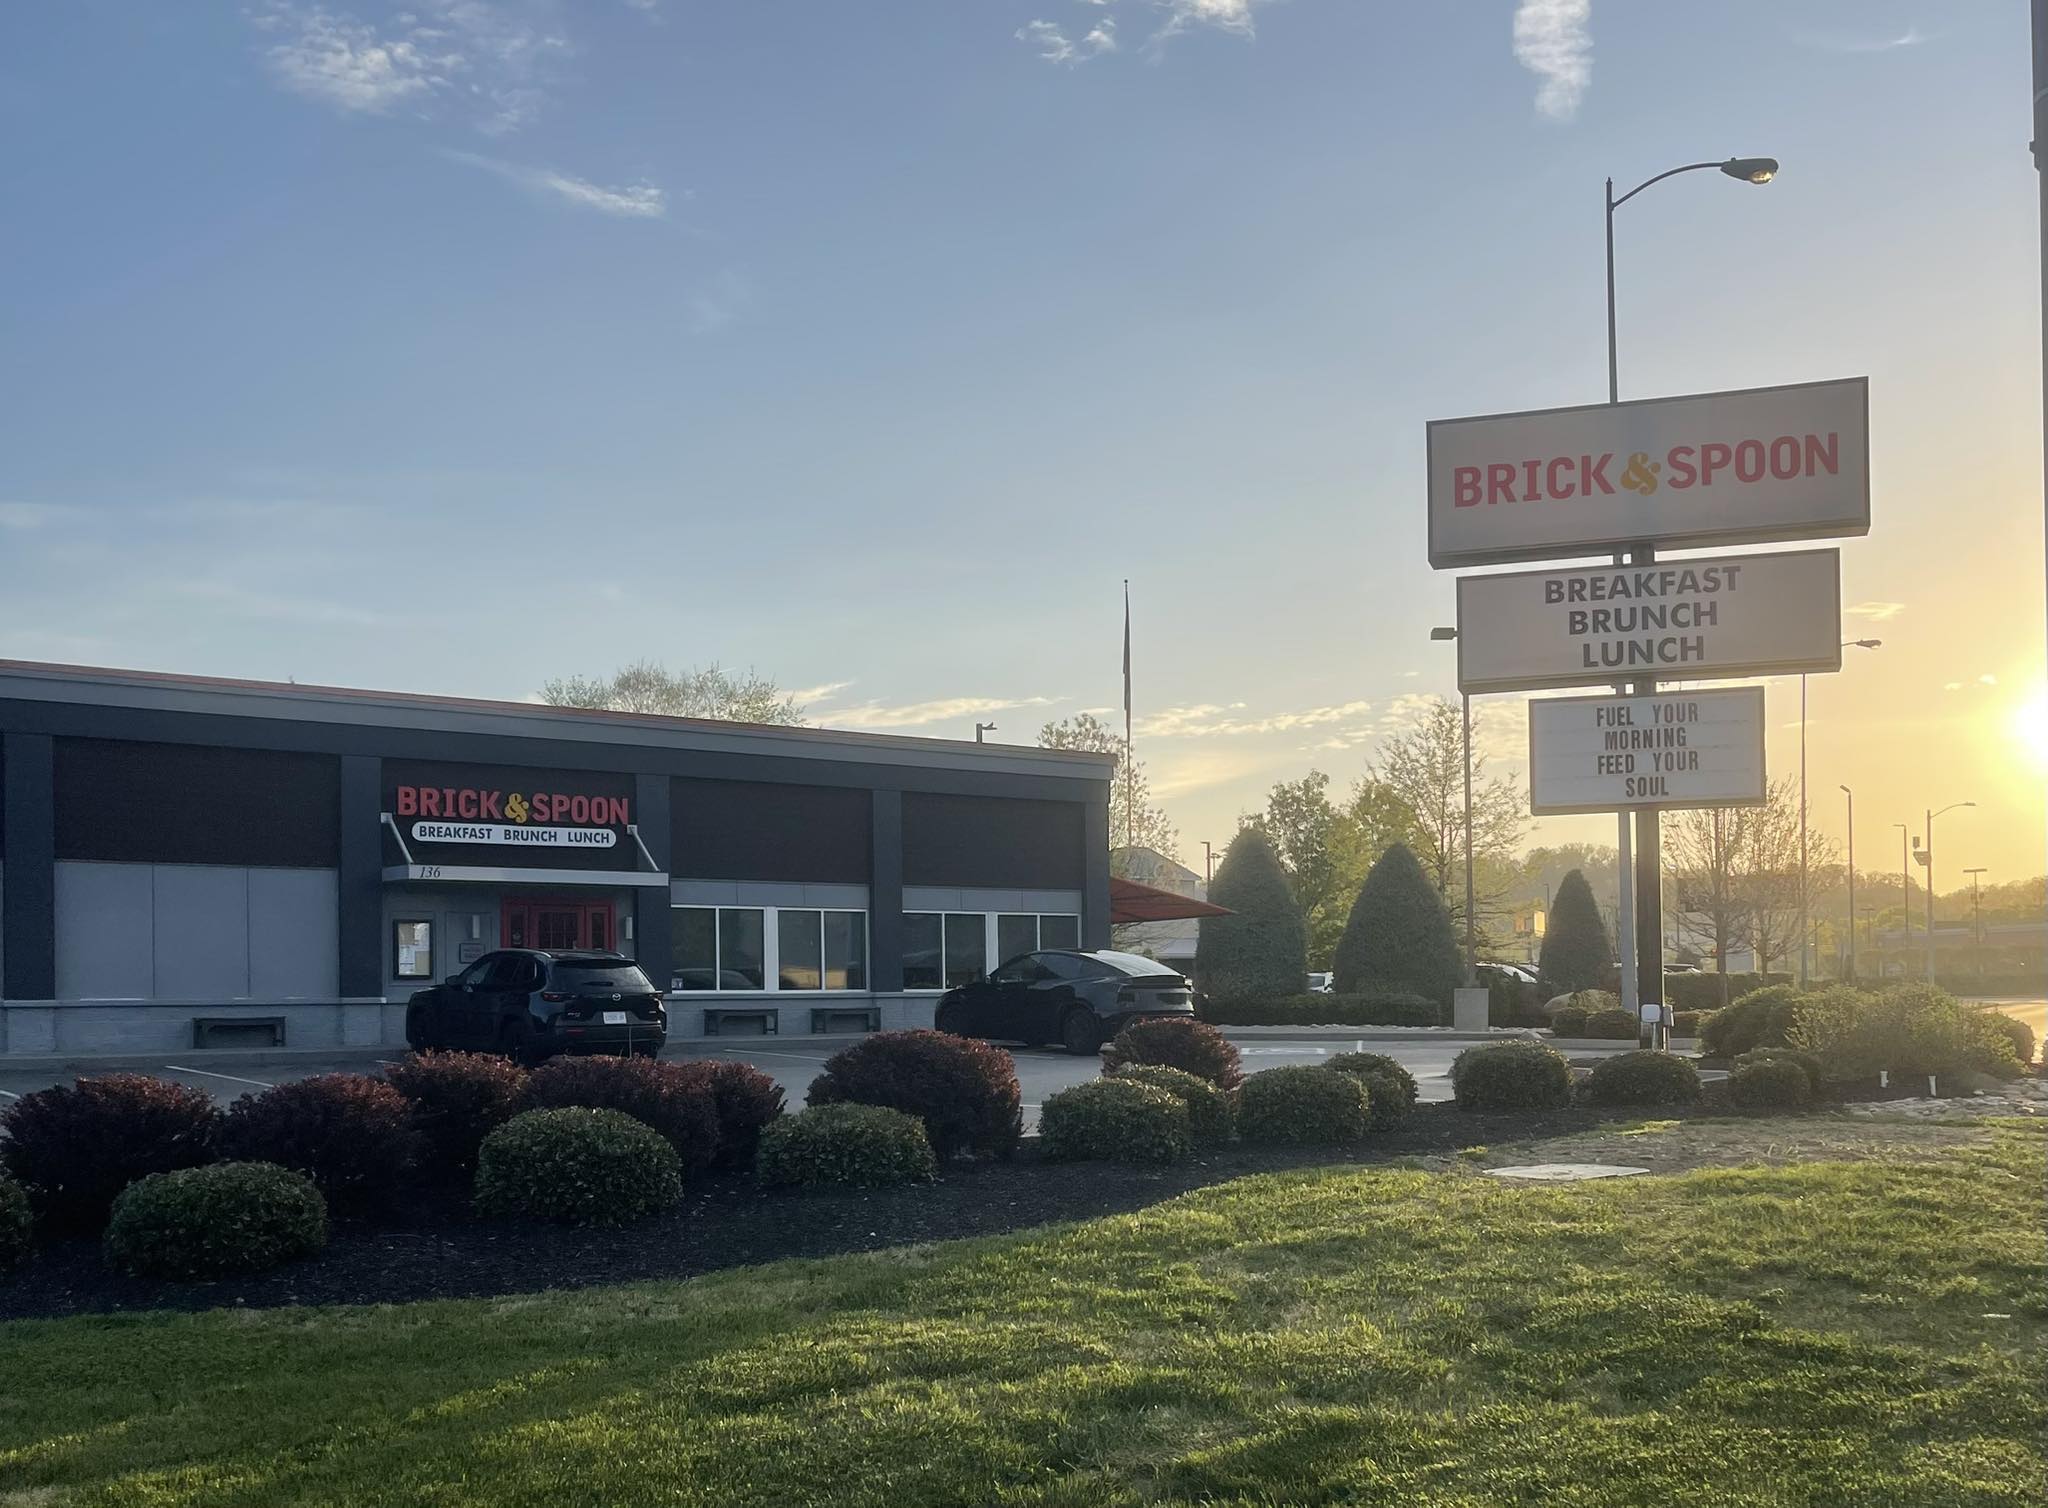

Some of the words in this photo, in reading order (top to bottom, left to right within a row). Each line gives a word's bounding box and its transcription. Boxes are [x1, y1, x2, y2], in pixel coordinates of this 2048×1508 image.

[1545, 566, 1741, 604] BREAKFAST
[1569, 601, 1718, 635] BRUNCH
[1583, 636, 1705, 668] LUNCH
[1596, 706, 1634, 728] FUEL
[1653, 702, 1699, 724] YOUR
[1604, 727, 1687, 751] MORNING
[1597, 754, 1635, 775] FEED
[1653, 751, 1699, 772] YOUR
[1625, 777, 1670, 798] SOUL
[419, 825, 492, 840] BREAKFAST
[504, 829, 557, 842] BRUNCH
[568, 832, 610, 844] LUNCH
[419, 866, 441, 879] 136
